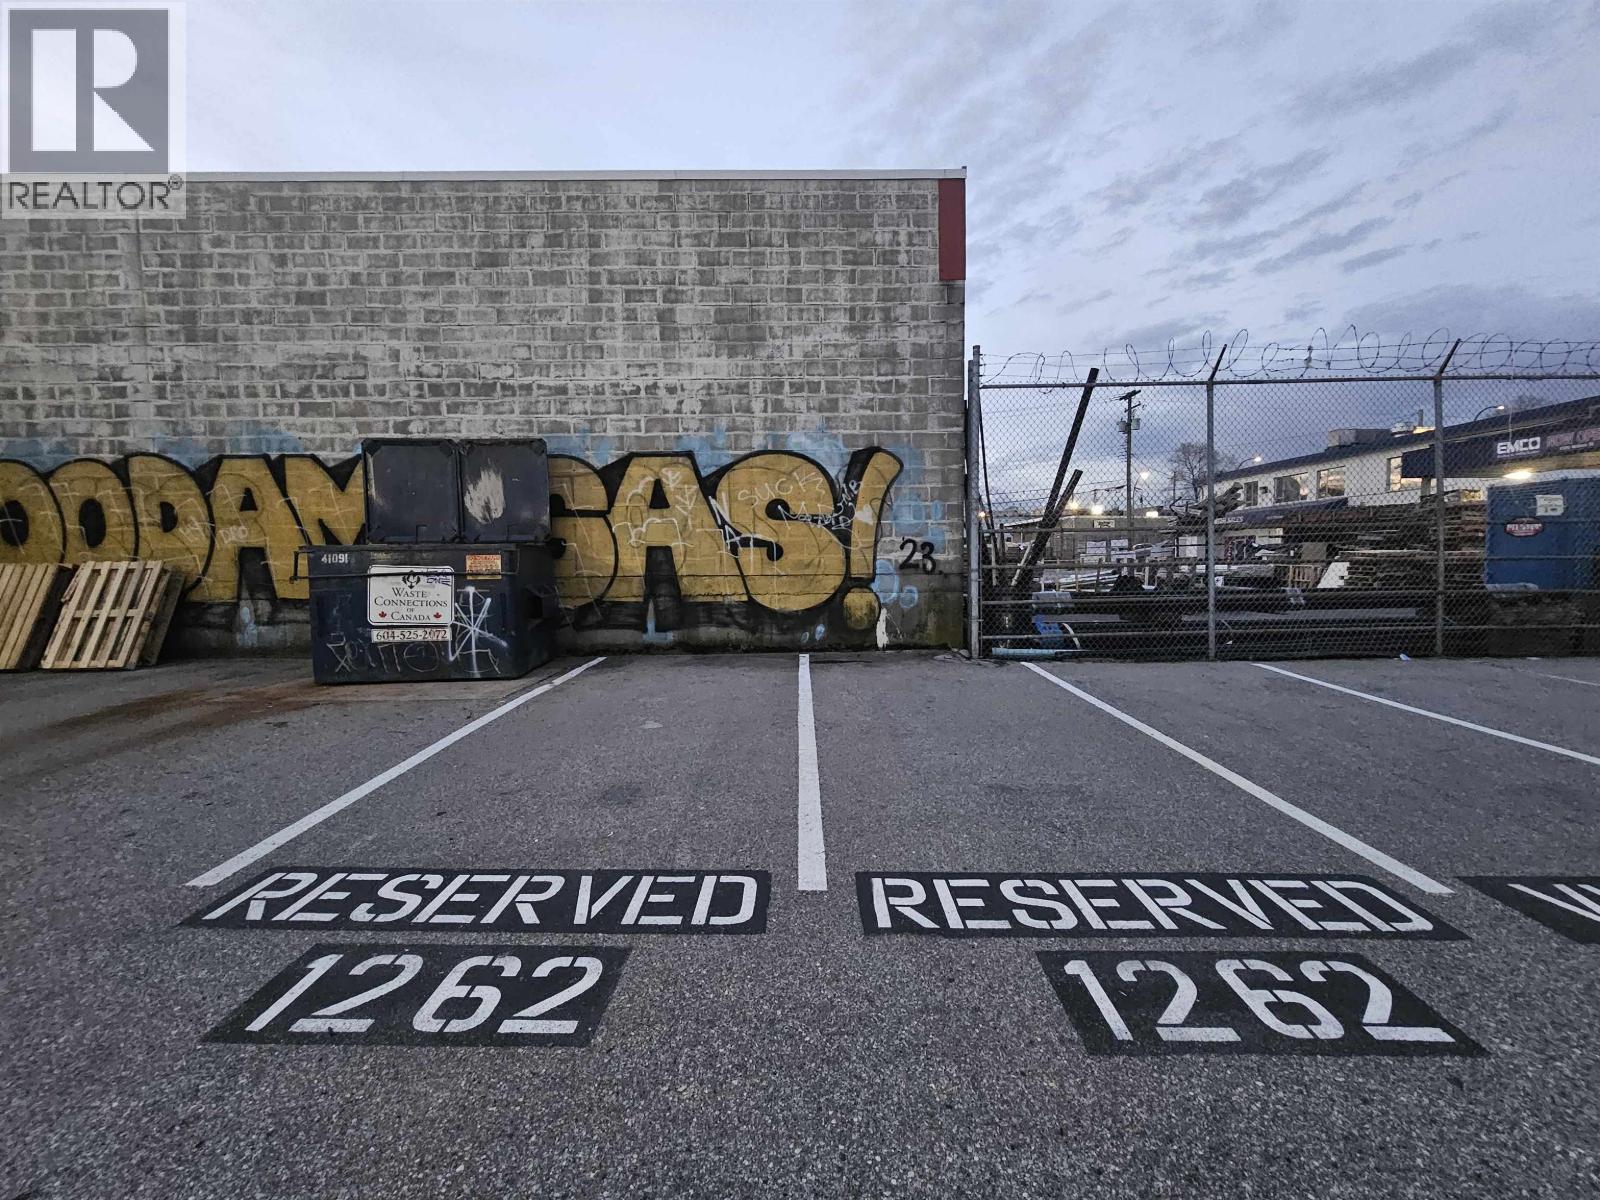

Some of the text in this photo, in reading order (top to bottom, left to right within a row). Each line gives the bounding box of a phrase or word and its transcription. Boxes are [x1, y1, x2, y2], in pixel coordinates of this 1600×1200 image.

[1497, 437, 1541, 455] EMCO
[374, 596, 448, 608] CONNECTIONS
[392, 587, 428, 599] WASTE
[390, 611, 431, 621] CANADA
[376, 629, 447, 640] 604-525-2072
[202, 871, 757, 927] RESERVED
[870, 876, 1435, 933] RESERVED
[244, 953, 604, 1034] 1262
[1064, 959, 1455, 1043] 1262
